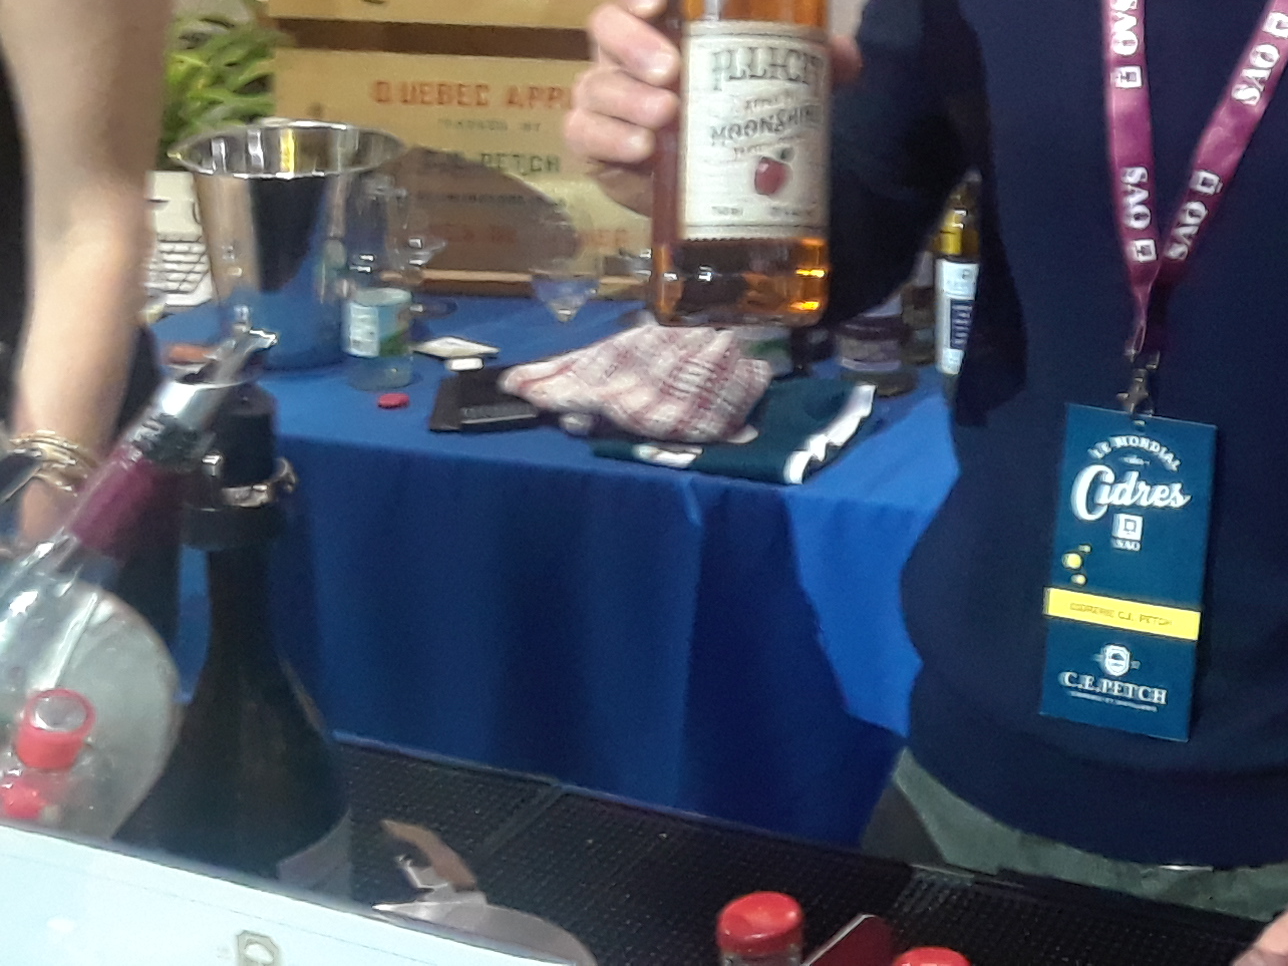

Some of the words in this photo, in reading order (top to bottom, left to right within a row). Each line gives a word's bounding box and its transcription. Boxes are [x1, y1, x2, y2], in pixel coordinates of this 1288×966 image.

[371, 79, 492, 108] QUEBEC
[1111, 435, 1181, 471] MONDIAL
[1071, 464, 1192, 521] Cidres
